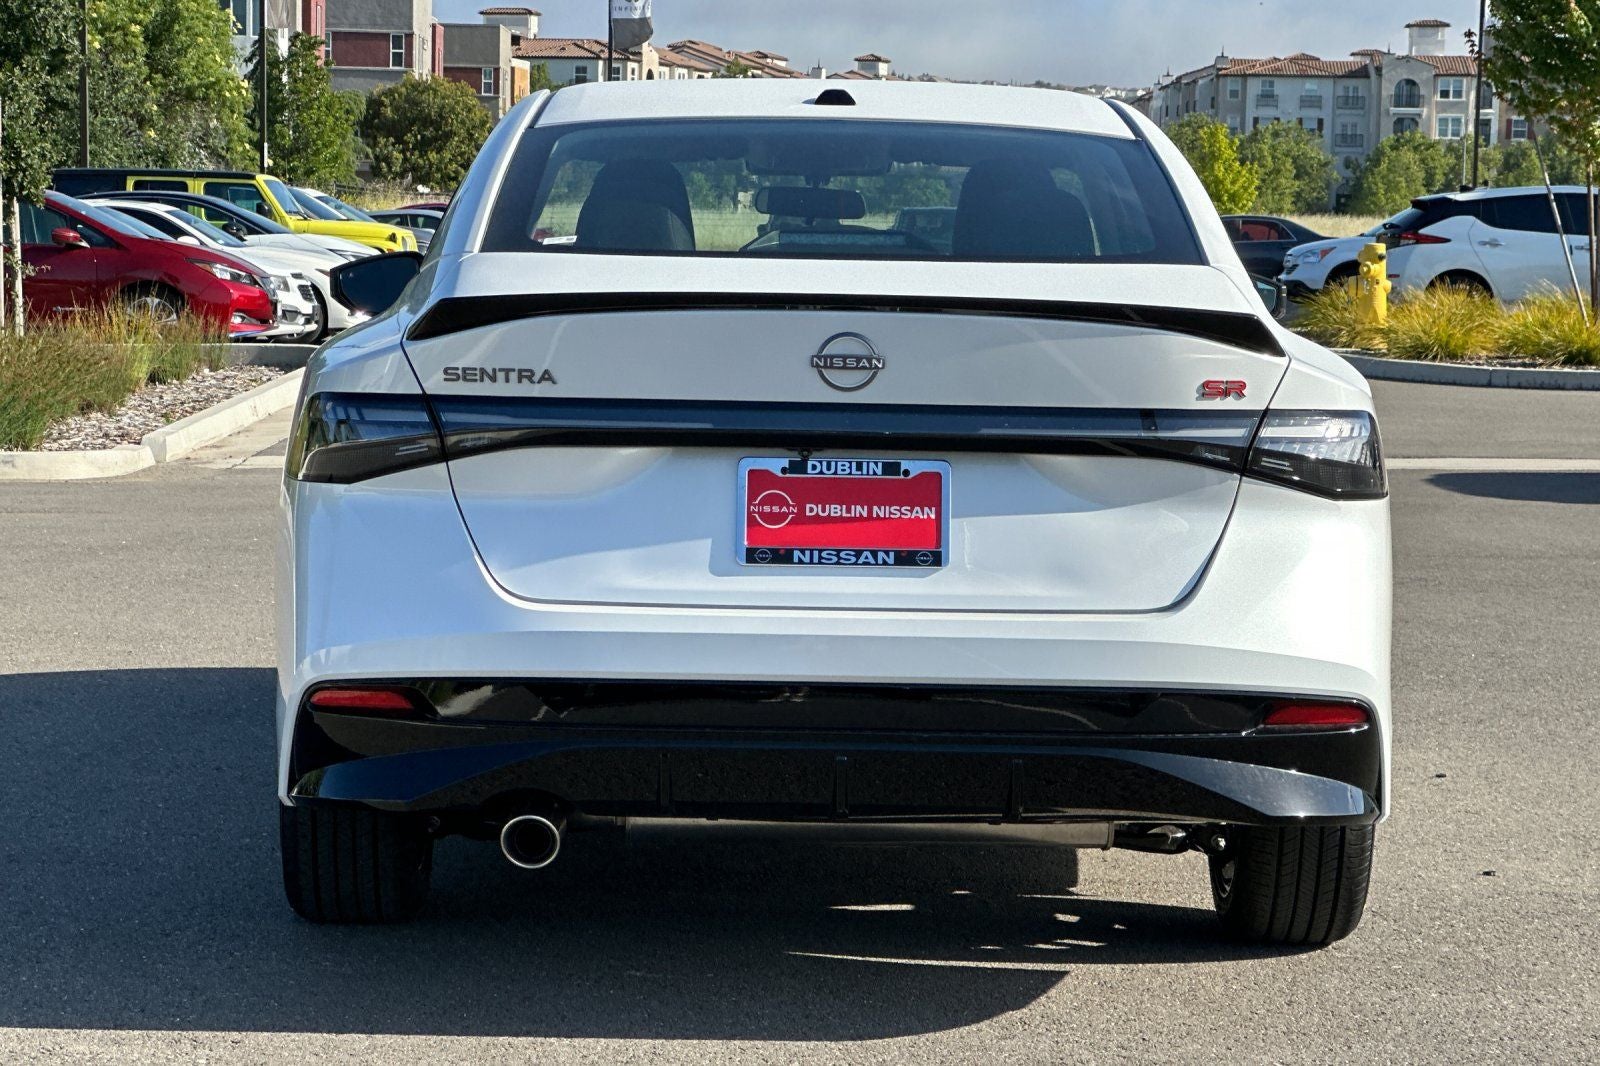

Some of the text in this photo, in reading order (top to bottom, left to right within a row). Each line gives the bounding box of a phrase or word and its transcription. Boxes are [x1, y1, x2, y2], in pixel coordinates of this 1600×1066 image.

[813, 357, 883, 368] NISSAN
[442, 366, 557, 385] SENTRA
[1202, 379, 1247, 398] SR
[806, 460, 883, 476] DUBLIN
[750, 505, 798, 514] NISSAN
[805, 503, 936, 520] DUBLIN NISSAN
[793, 550, 895, 565] NISSAN
